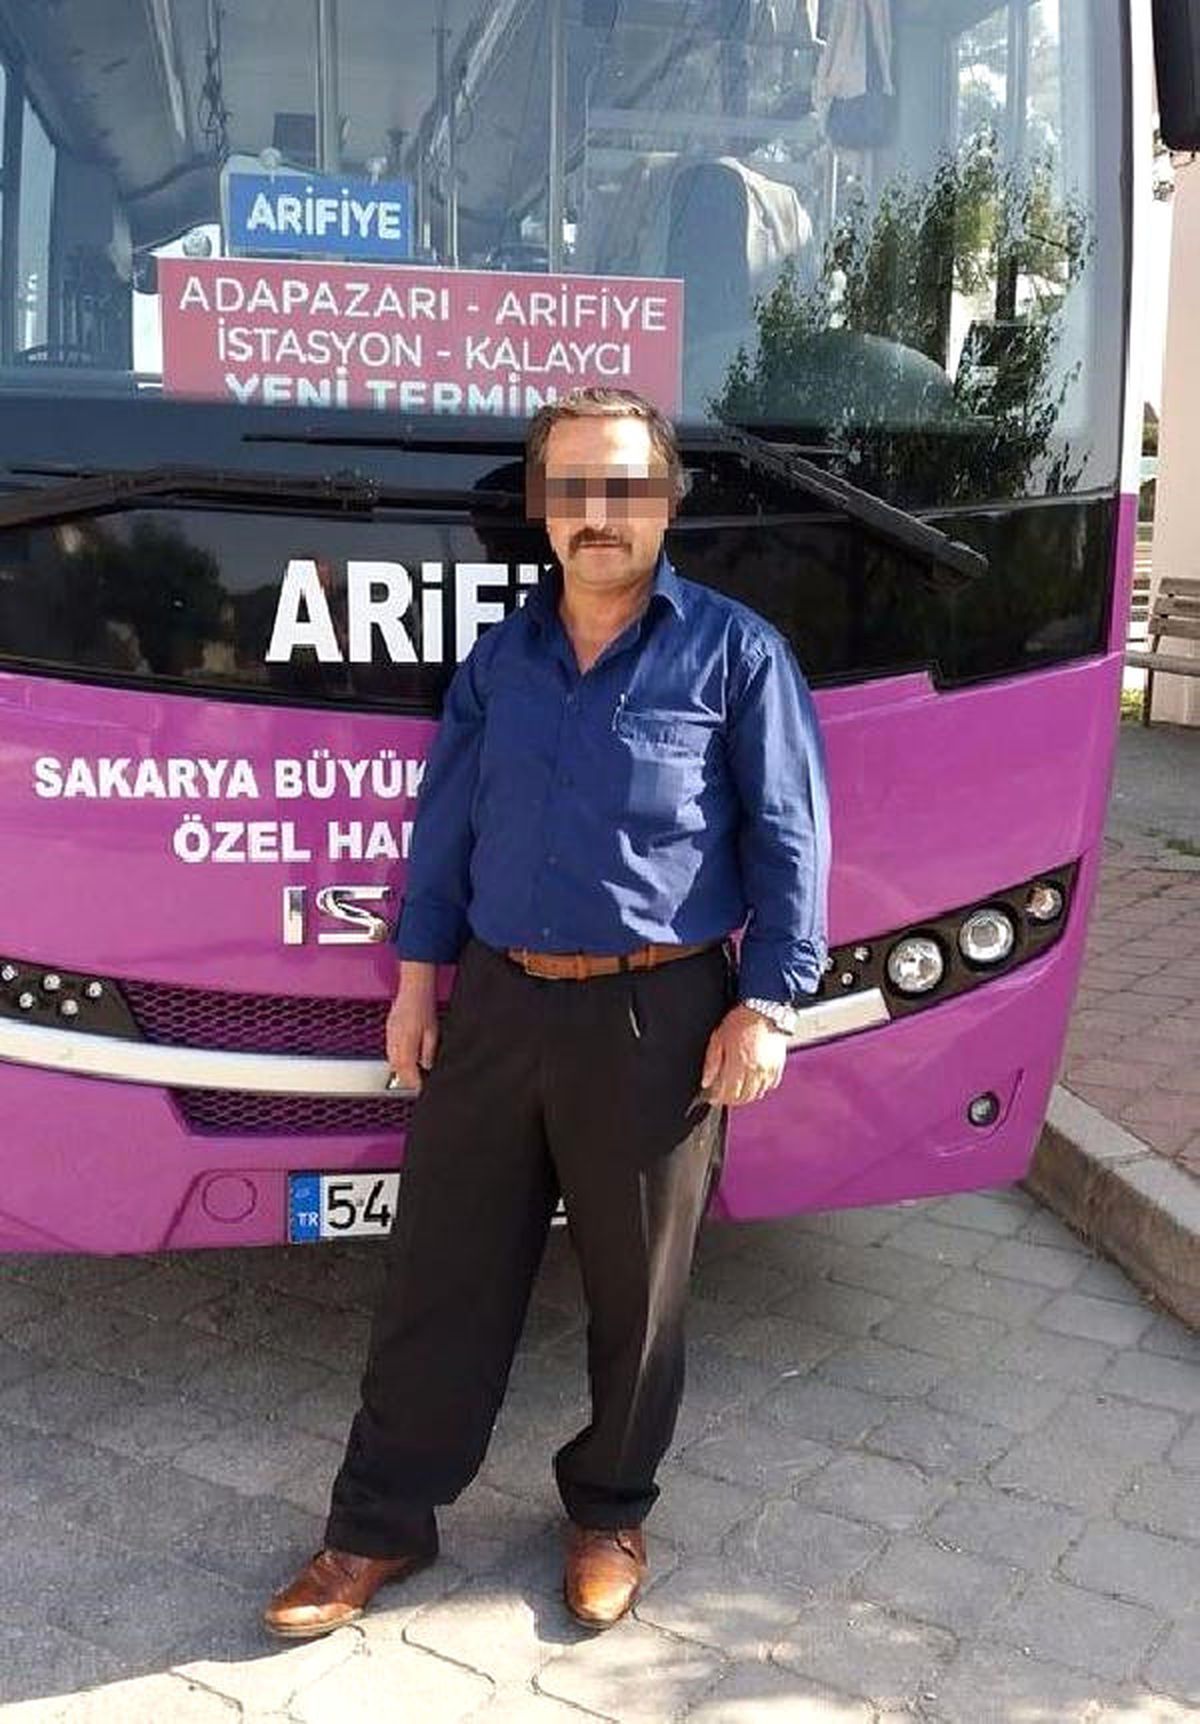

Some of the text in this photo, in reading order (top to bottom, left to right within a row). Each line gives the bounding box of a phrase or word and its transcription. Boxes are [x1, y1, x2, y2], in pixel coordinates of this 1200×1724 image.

[246, 185, 402, 240] ARİFİYE
[178, 276, 450, 321] ADAPAZARI
[495, 284, 668, 332] ARİFİYE
[217, 317, 422, 368] İSTASYON
[465, 335, 632, 376] KALAYCI
[225, 366, 348, 410] YENİ
[34, 757, 260, 799] SAKARYA
[173, 813, 312, 864] ÖZEL
[297, 1211, 319, 1228] TR
